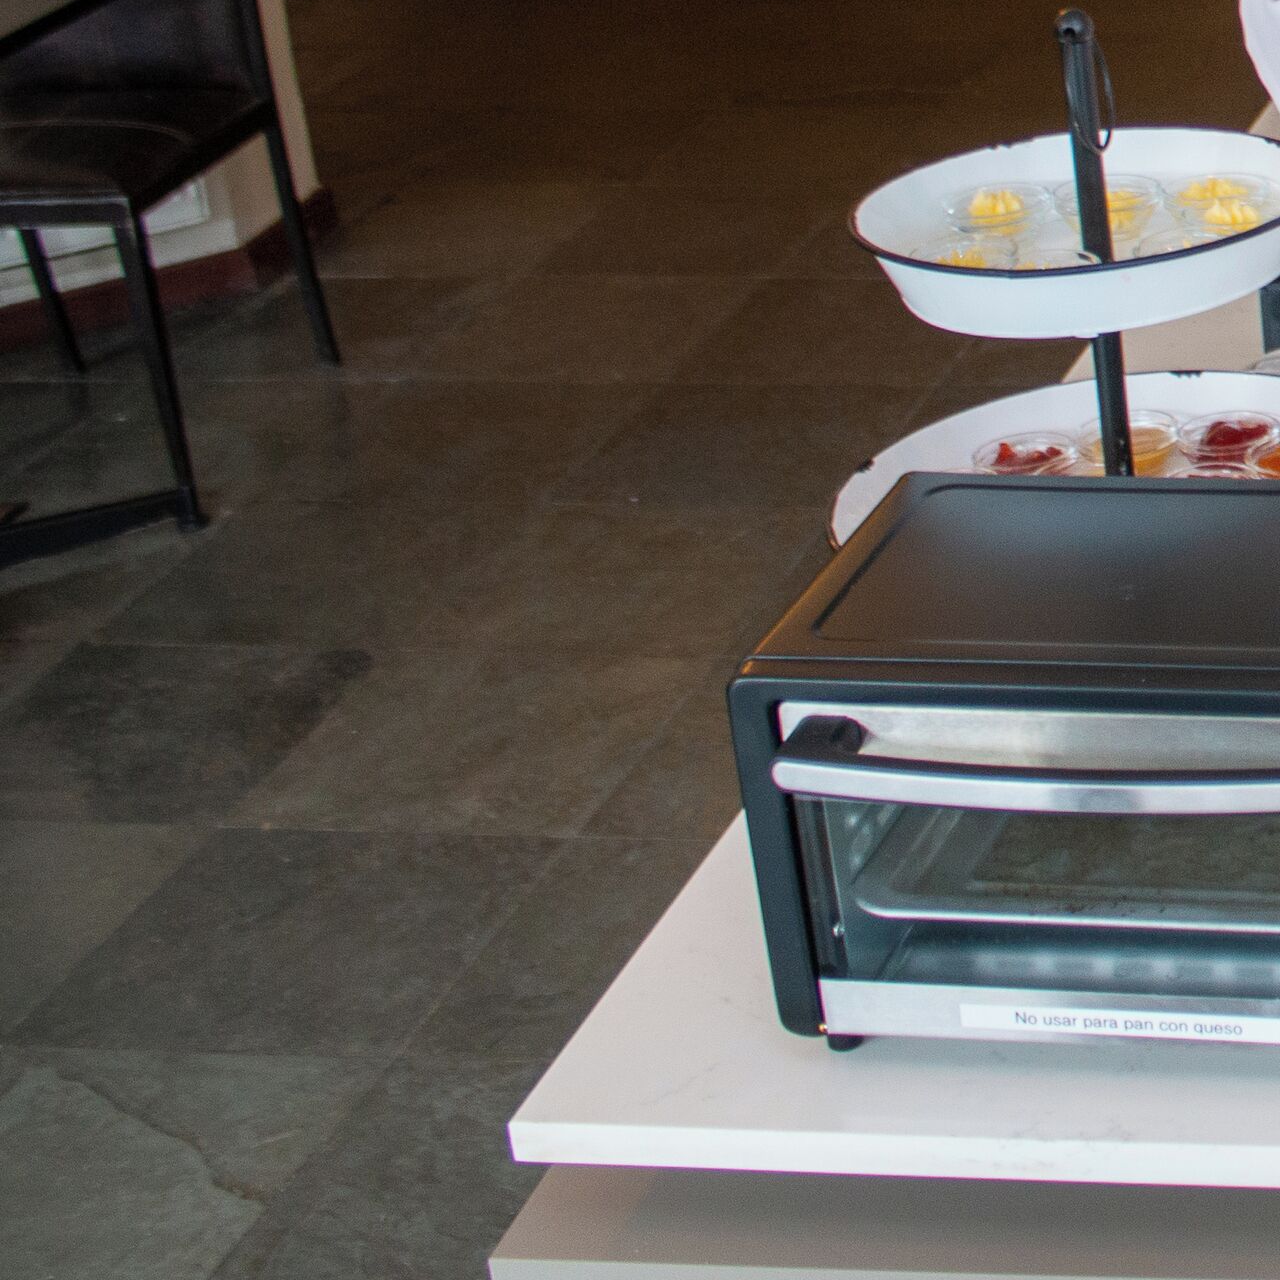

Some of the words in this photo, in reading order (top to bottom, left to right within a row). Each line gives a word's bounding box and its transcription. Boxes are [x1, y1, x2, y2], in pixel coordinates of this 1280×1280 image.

[1014, 1010, 1038, 1025] No
[1042, 1013, 1077, 1027] usar
[1083, 1017, 1119, 1030] para
[1124, 1019, 1154, 1032] pan
[1158, 1020, 1189, 1032] con
[1193, 1021, 1244, 1036] queso
